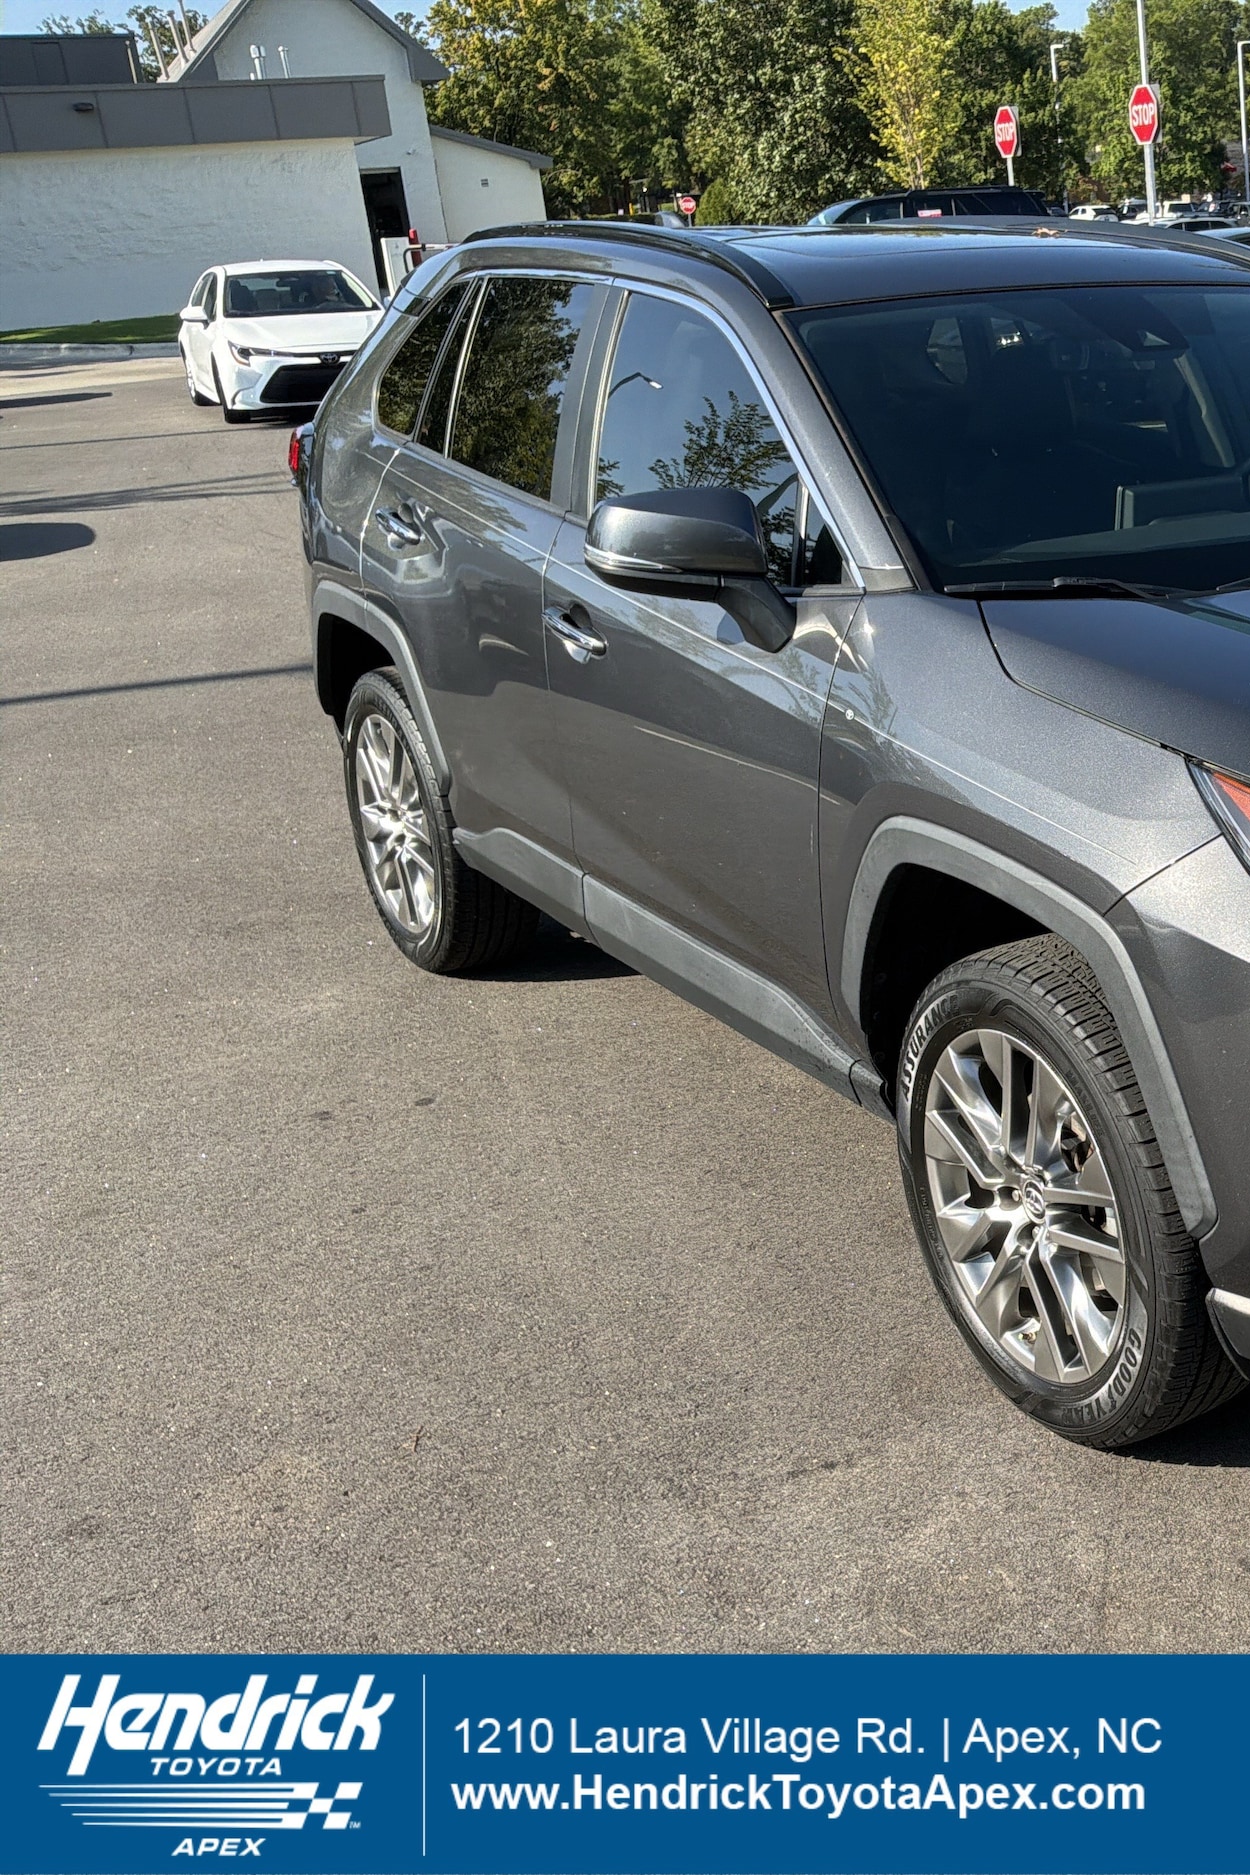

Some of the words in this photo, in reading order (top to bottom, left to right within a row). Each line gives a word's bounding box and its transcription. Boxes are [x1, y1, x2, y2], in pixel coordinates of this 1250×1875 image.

[996, 123, 1015, 142] STOP
[1131, 102, 1155, 127] STOP
[900, 994, 961, 1102] ASSURANCE
[1062, 1327, 1142, 1426] GOODYEAR
